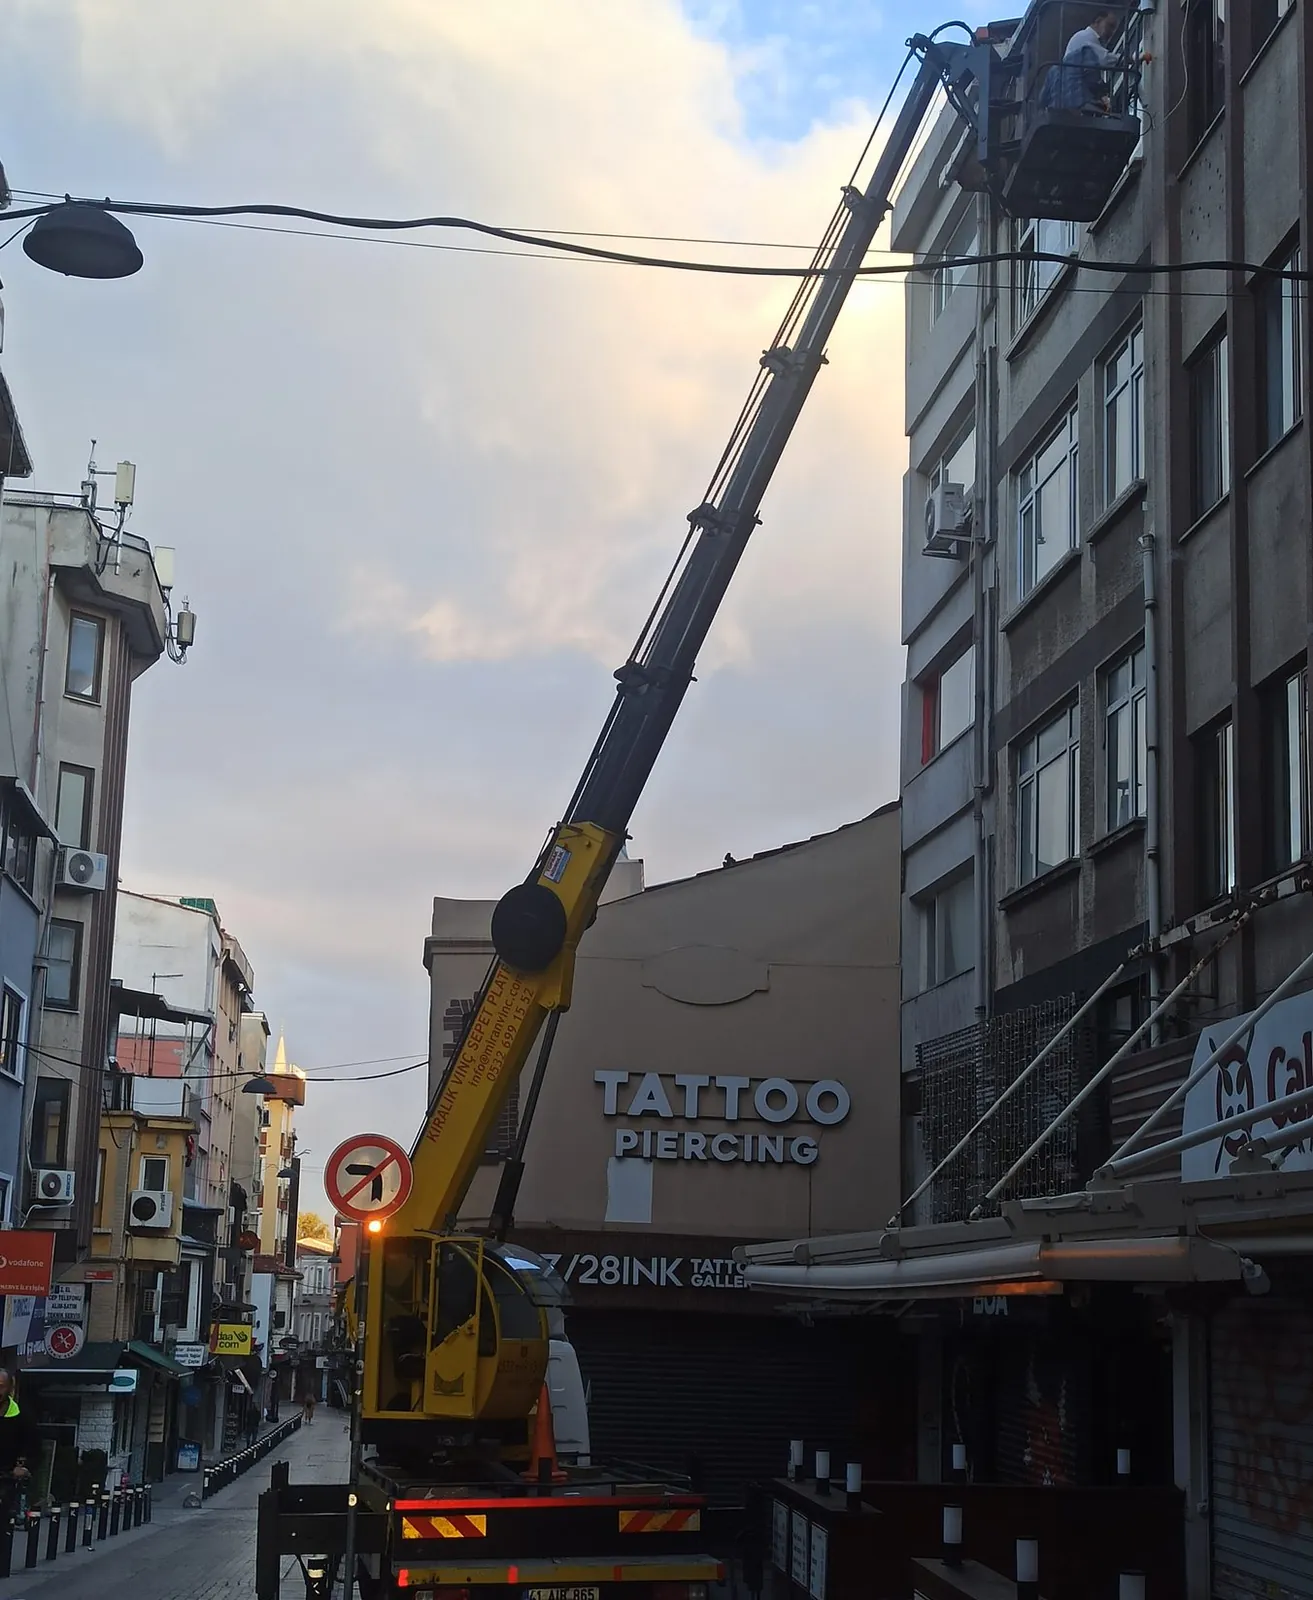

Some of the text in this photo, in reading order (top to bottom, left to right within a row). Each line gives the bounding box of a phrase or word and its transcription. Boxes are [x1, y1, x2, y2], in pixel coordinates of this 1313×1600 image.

[487, 987, 535, 1082] 0532 699 15 52
[428, 1088, 458, 1142] KIRALIK
[466, 1006, 494, 1050] SEPET
[594, 1070, 850, 1125] TATTOO
[616, 1128, 819, 1165] PIERCING
[8, 1259, 45, 1268] vodafone
